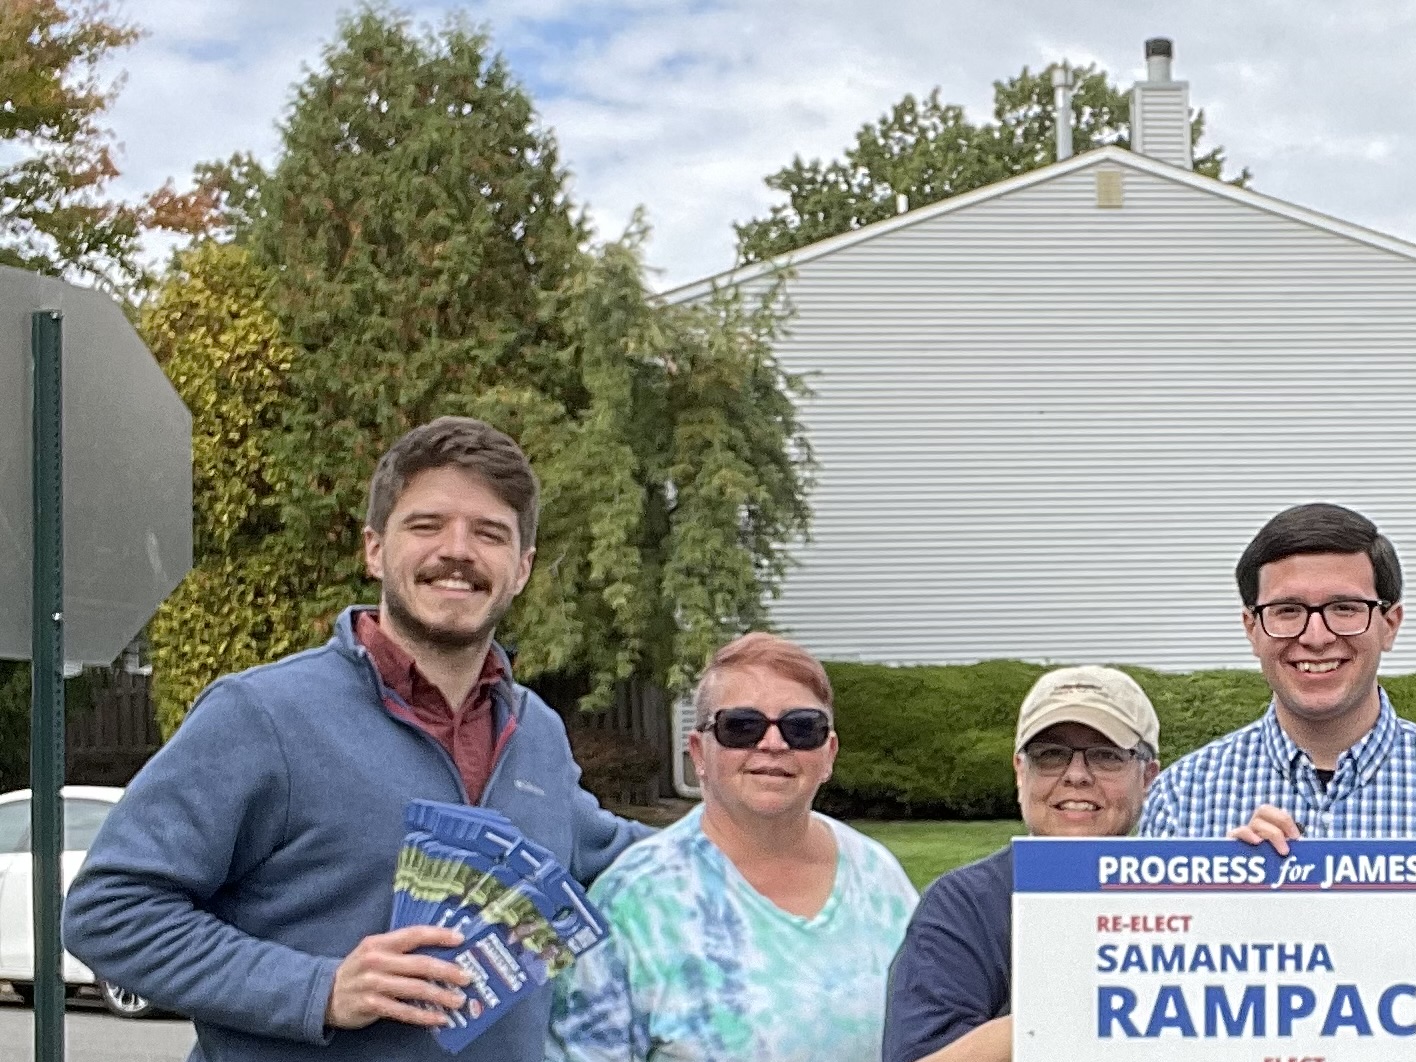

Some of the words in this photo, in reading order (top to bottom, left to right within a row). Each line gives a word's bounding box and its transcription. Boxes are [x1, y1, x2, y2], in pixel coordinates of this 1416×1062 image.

[1099, 855, 1266, 884] PROGRESS
[1271, 855, 1315, 888] for
[1096, 915, 1192, 933] RE-ELECT
[1097, 943, 1335, 973] SAMANTHA
